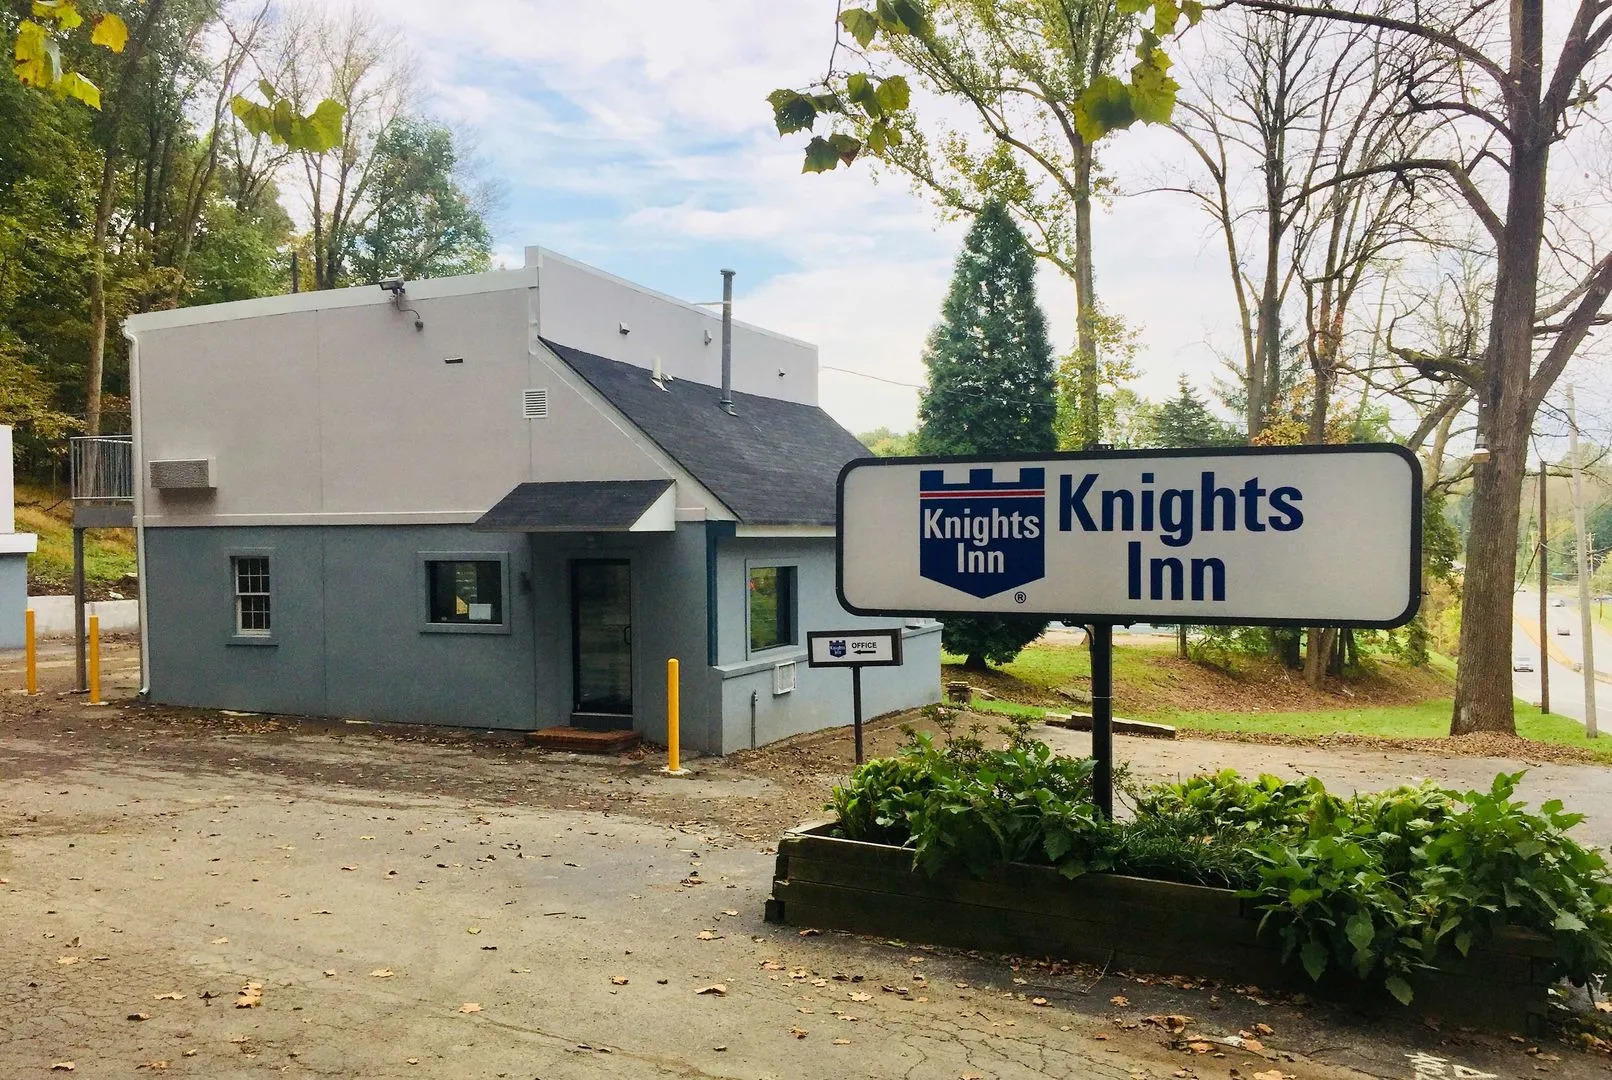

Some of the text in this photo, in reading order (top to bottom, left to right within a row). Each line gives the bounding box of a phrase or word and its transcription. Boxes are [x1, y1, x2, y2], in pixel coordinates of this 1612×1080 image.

[924, 507, 1040, 547] Knights
[1059, 471, 1304, 547] Knights
[957, 542, 1005, 573] Inn
[1128, 541, 1226, 601] Inn
[851, 641, 877, 649] OFFICE
